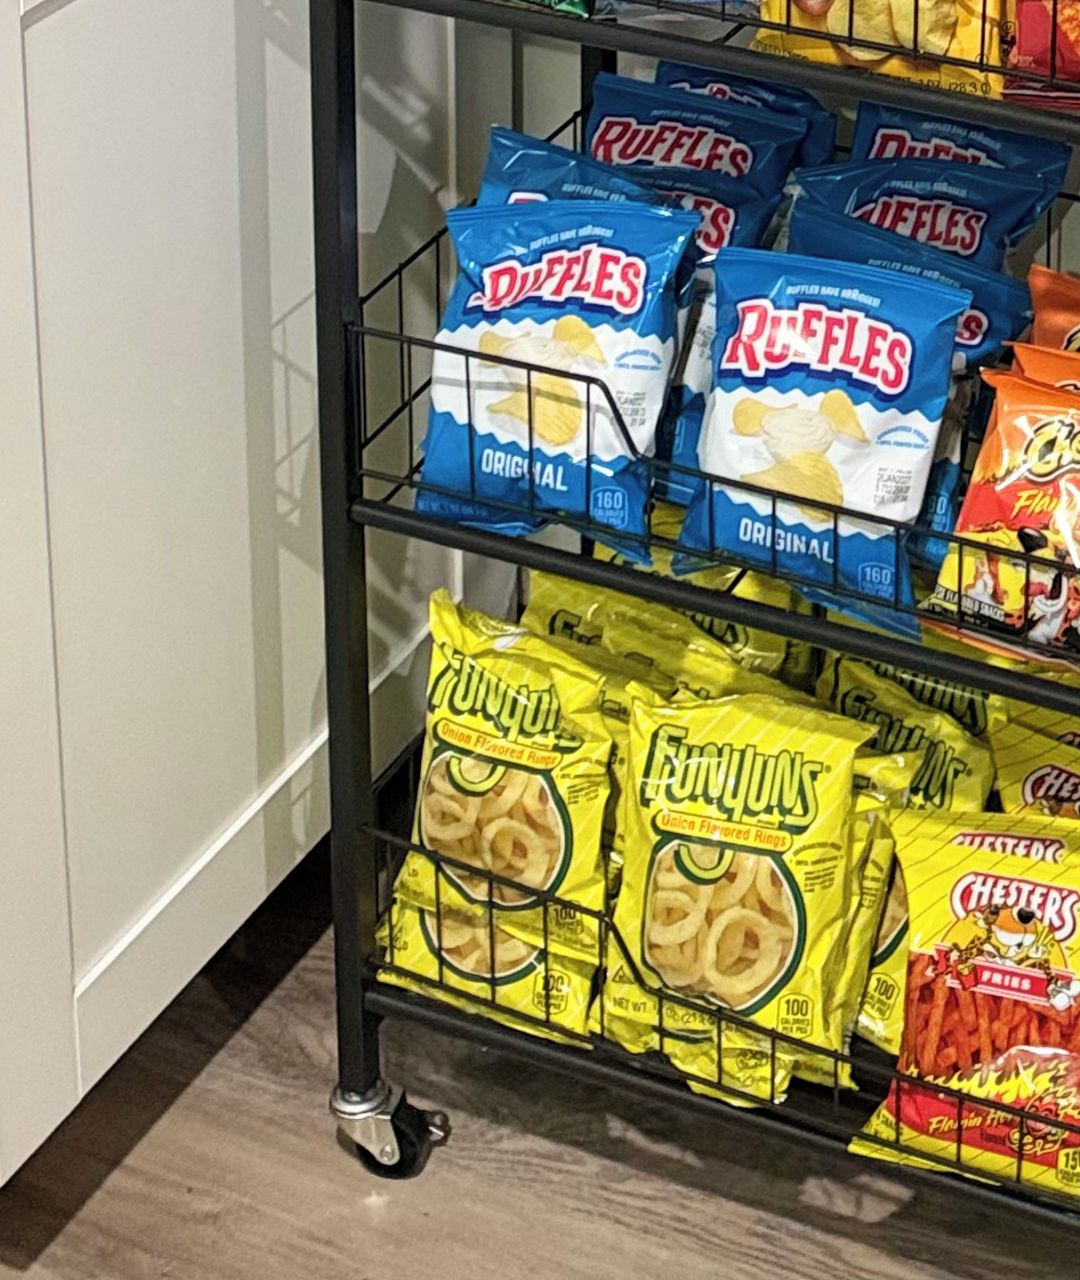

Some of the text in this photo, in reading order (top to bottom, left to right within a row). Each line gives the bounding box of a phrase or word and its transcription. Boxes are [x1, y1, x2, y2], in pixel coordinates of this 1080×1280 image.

[592, 119, 750, 177] RUFFLES
[725, 302, 911, 391] RUFFLES
[594, 489, 624, 509] 160
[738, 517, 834, 565] ORIGINAL
[865, 566, 892, 585] 160
[442, 722, 473, 745] Onion
[643, 723, 822, 829] FUNYUNS
[661, 811, 787, 849] Onion Flavored Rings
[873, 977, 896, 1000] 100
[981, 969, 1032, 992] FRIES
[784, 1000, 810, 1018] 100
